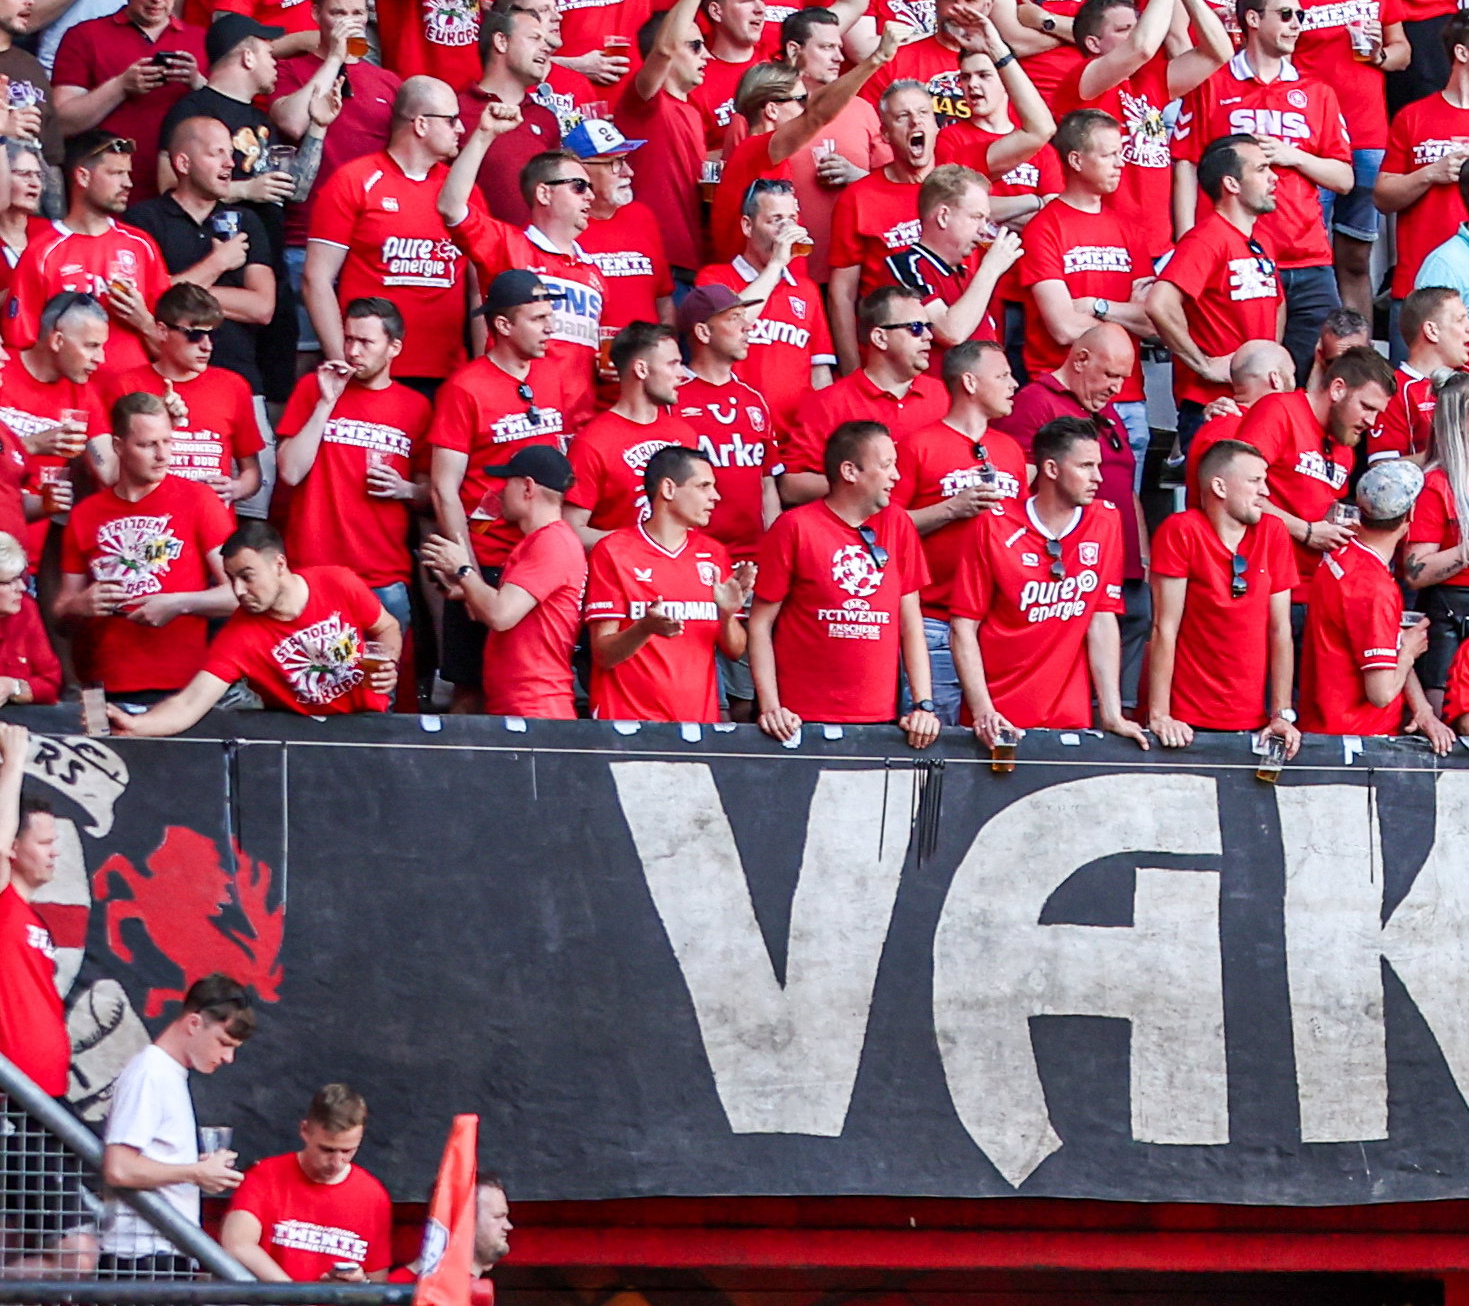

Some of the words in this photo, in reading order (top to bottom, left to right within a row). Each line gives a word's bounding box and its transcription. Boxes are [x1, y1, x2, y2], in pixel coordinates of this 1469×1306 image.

[1230, 109, 1310, 139] SNS
[383, 237, 431, 261] pure
[390, 259, 446, 276] energie
[1029, 598, 1085, 622] energie
